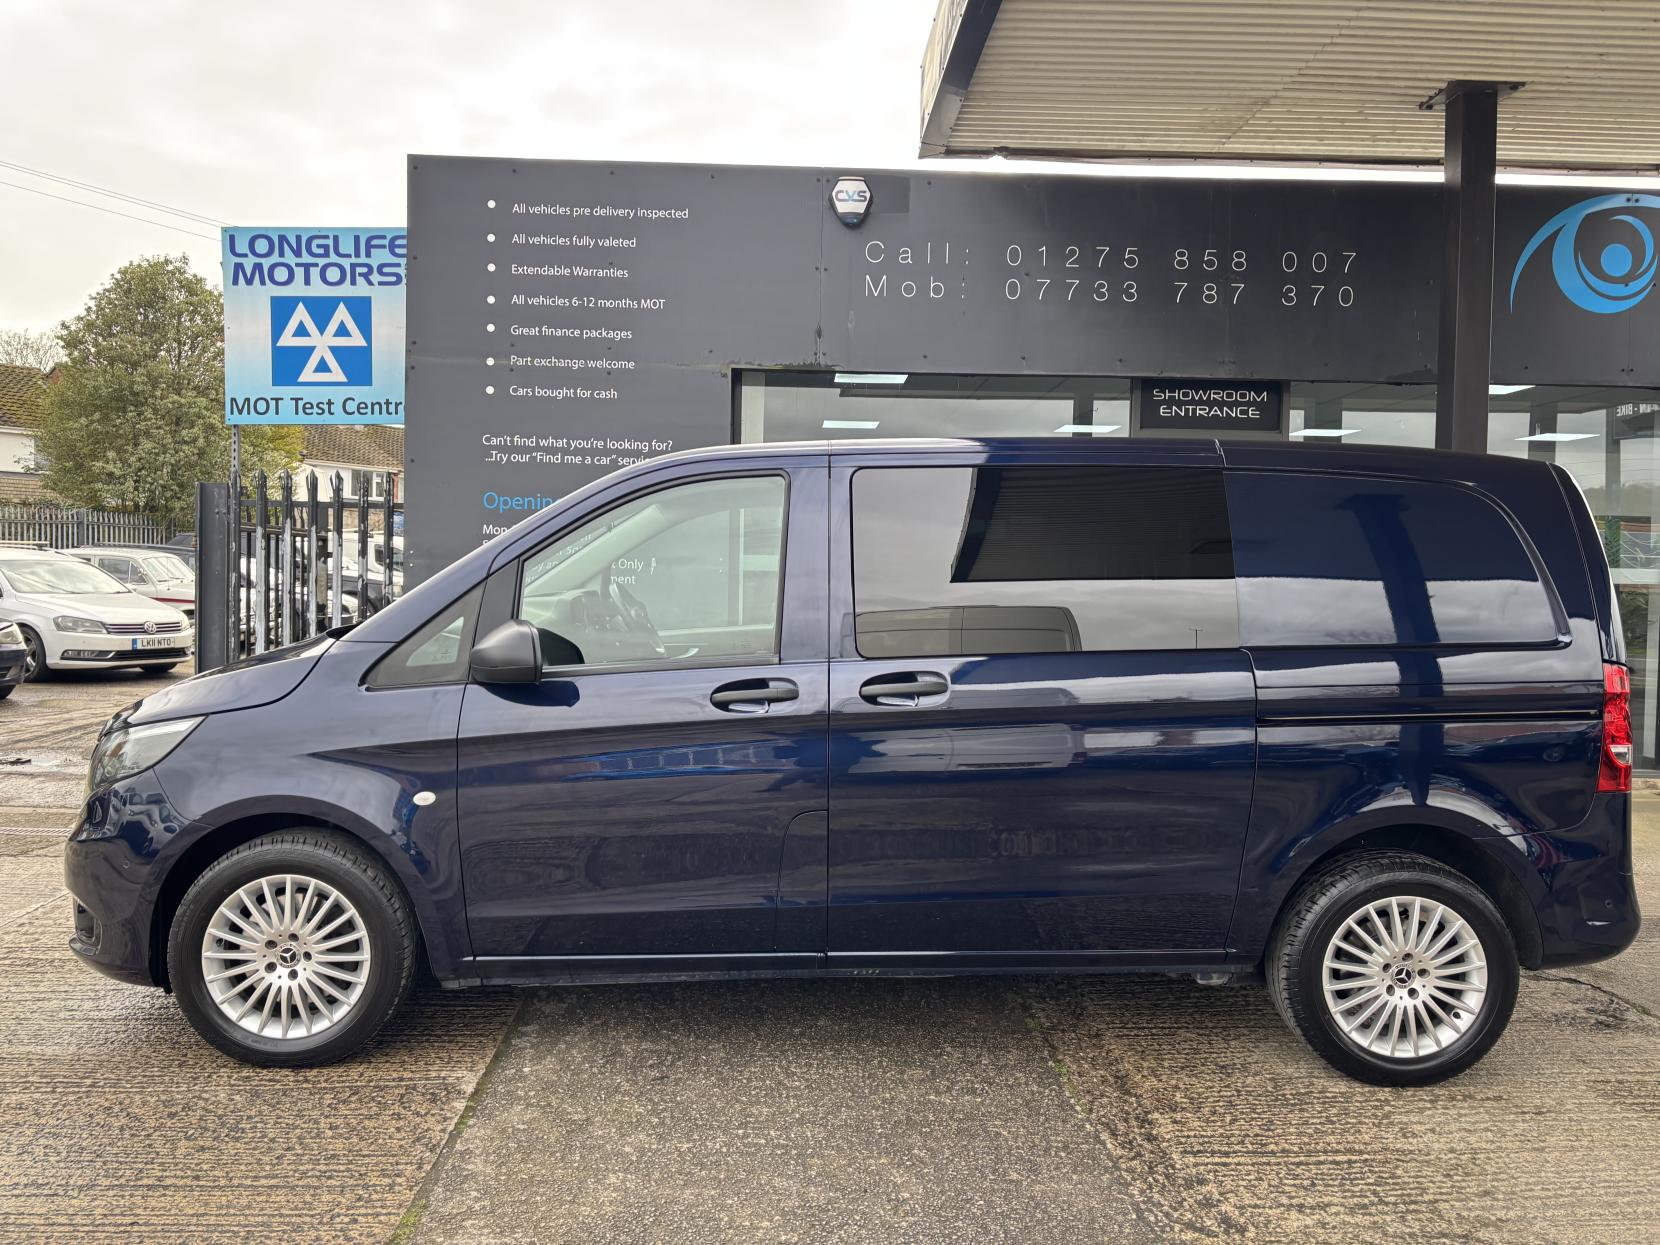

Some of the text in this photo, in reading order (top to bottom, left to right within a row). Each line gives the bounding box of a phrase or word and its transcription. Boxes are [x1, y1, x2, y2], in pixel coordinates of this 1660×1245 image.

[835, 190, 867, 202] CVS
[512, 203, 689, 221] All vehicles pre delivery inspected
[229, 233, 407, 259] LONGLIFE
[512, 233, 637, 249] All vehicles fully valeted
[863, 239, 1357, 273] Call: 01275 858 007
[231, 262, 404, 287] MOTORS
[511, 263, 629, 278] Extendable Warranties
[863, 273, 1355, 307] Mob: 07733 787 370
[511, 294, 667, 309] All vehicles 6-12 months MOT
[510, 324, 633, 341] Great finance packages
[510, 355, 636, 370] Part exchange welcome
[509, 385, 618, 400] Cars bought for cash
[1153, 388, 1267, 402] SHOWROOM
[229, 396, 404, 416] MOT Test Centr
[1160, 405, 1261, 418] ENTRANCE
[482, 434, 673, 452] Can't find what you're looking for?
[511, 454, 530, 462] our
[532, 452, 561, 463] "Find
[564, 455, 582, 464] me
[585, 456, 592, 464] a
[594, 454, 617, 465] car"
[618, 456, 649, 466] servi
[483, 491, 559, 513] Openin
[618, 558, 644, 572] Only
